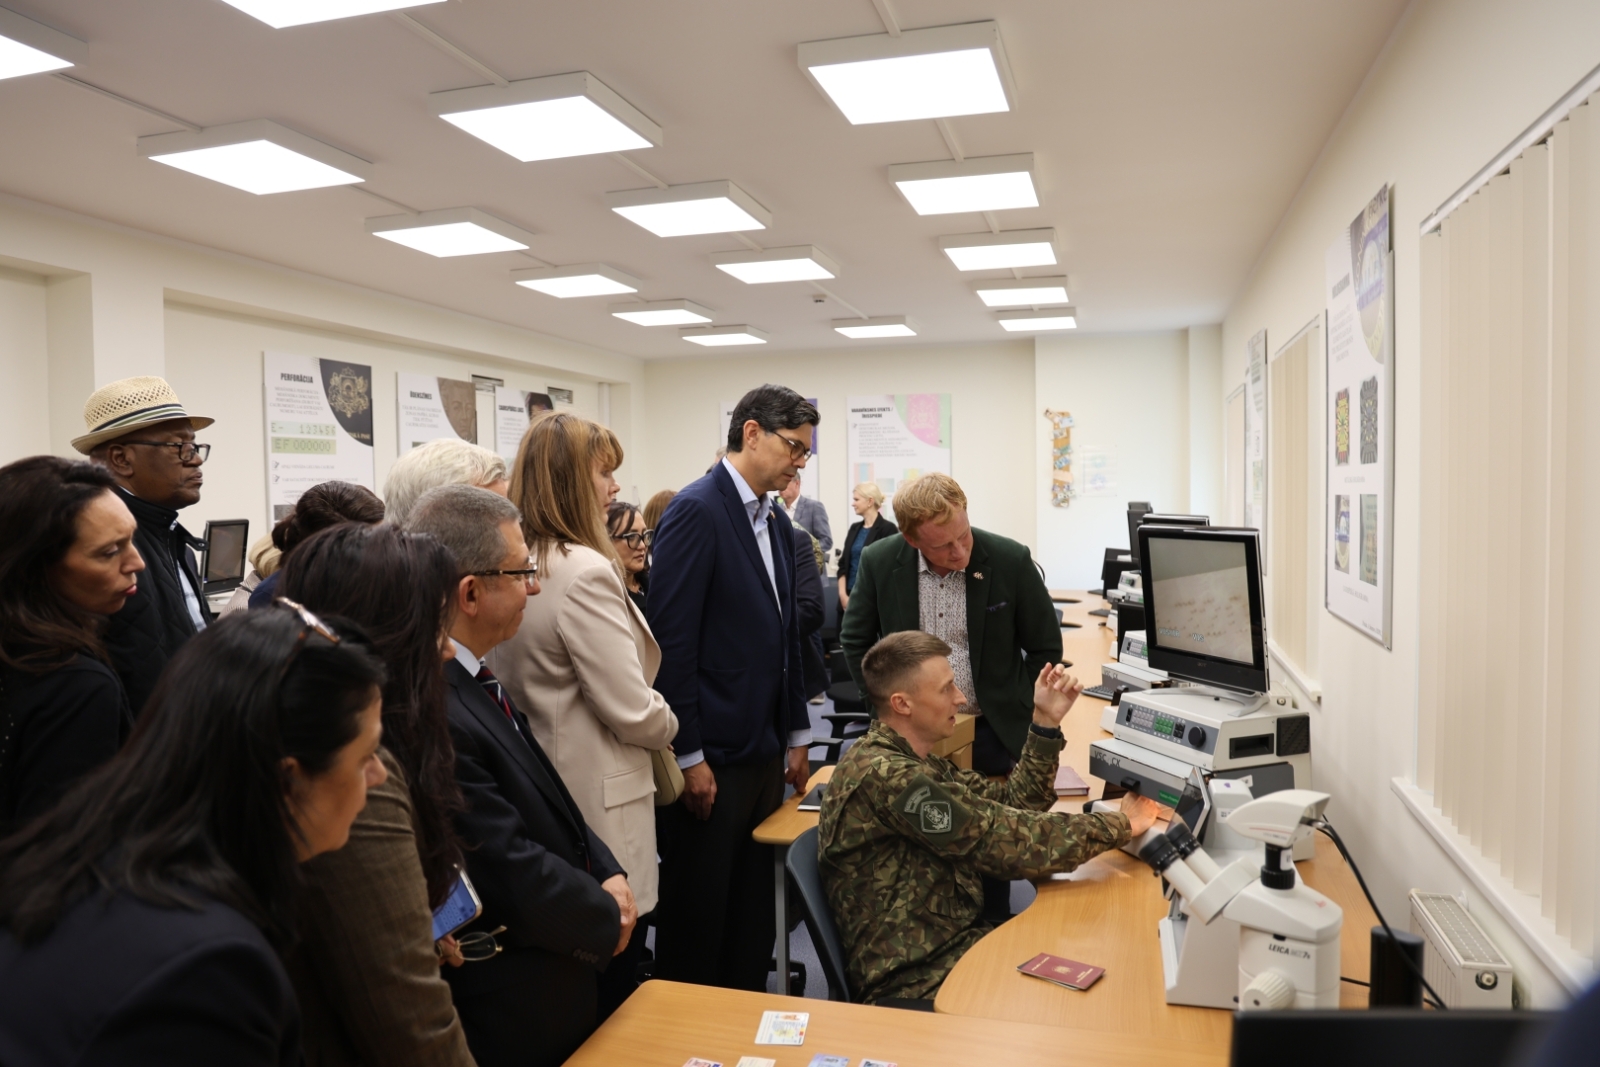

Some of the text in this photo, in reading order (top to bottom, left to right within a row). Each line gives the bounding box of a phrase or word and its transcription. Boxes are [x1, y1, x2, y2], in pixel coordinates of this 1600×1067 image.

[299, 423, 336, 436] 123456
[275, 438, 331, 452] EF 000000
[1094, 750, 1107, 763] VSC
[1268, 943, 1290, 956] LEICA
